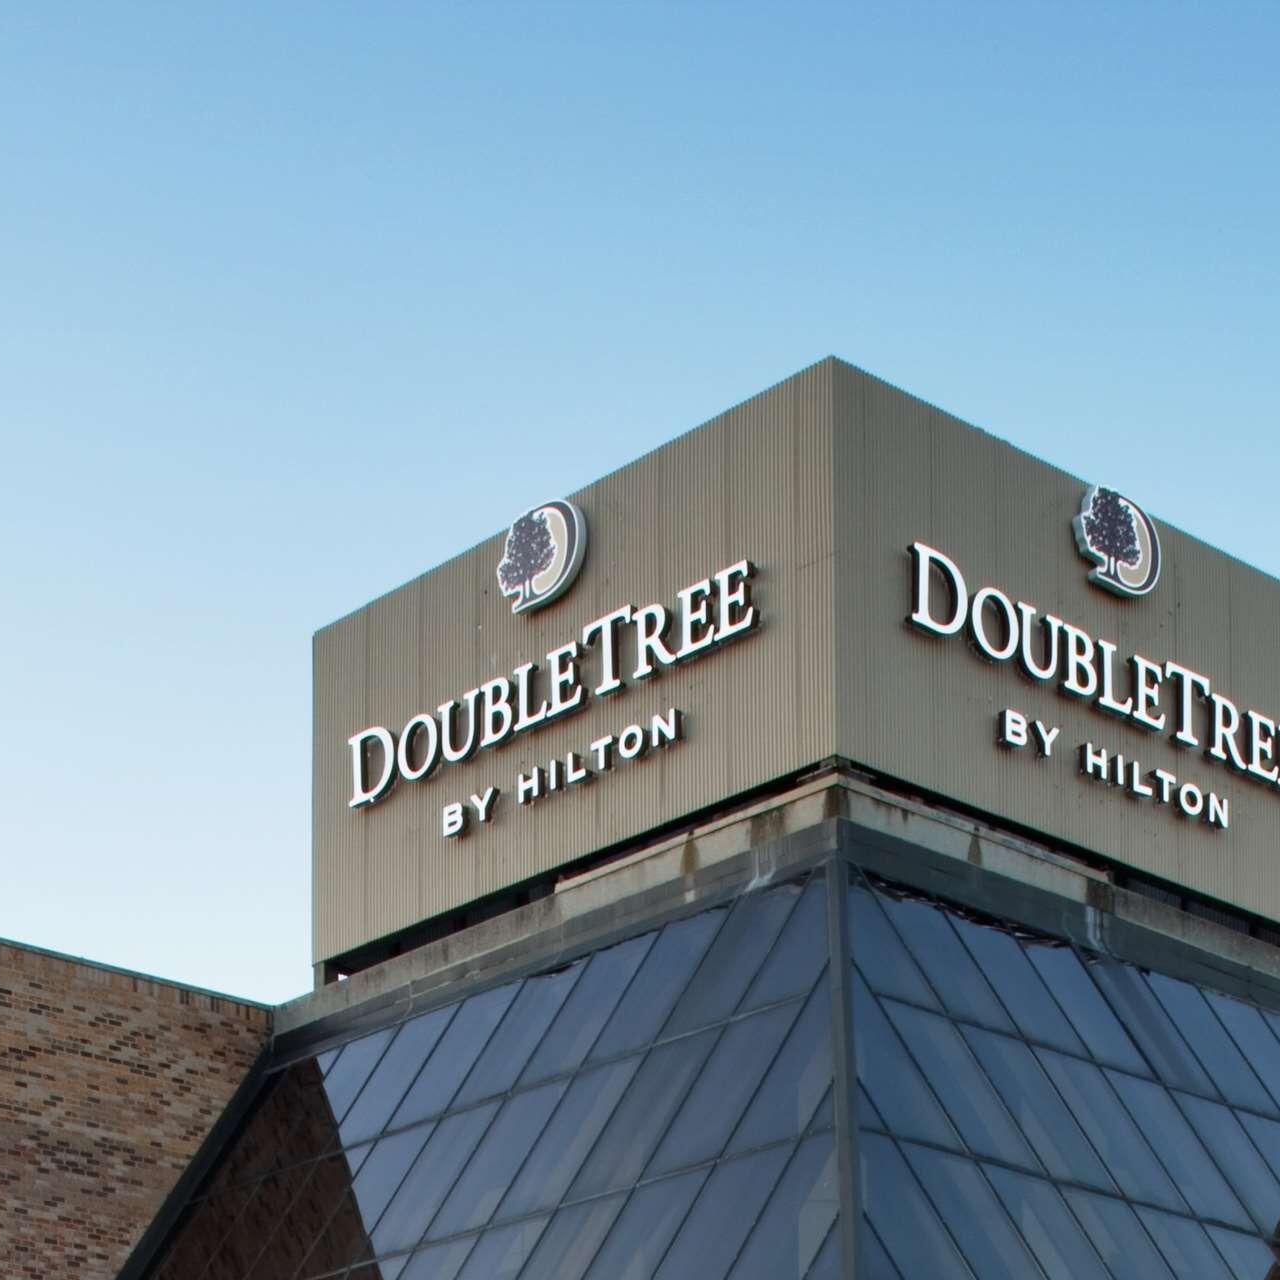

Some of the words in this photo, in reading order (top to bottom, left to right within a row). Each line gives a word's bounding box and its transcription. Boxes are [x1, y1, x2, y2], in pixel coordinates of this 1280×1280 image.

[347, 559, 756, 809] DOUBLETREE
[442, 786, 497, 838] BY
[517, 707, 681, 805] HILTON
[1002, 709, 1060, 757] BY
[1084, 742, 1230, 828] HILTON
